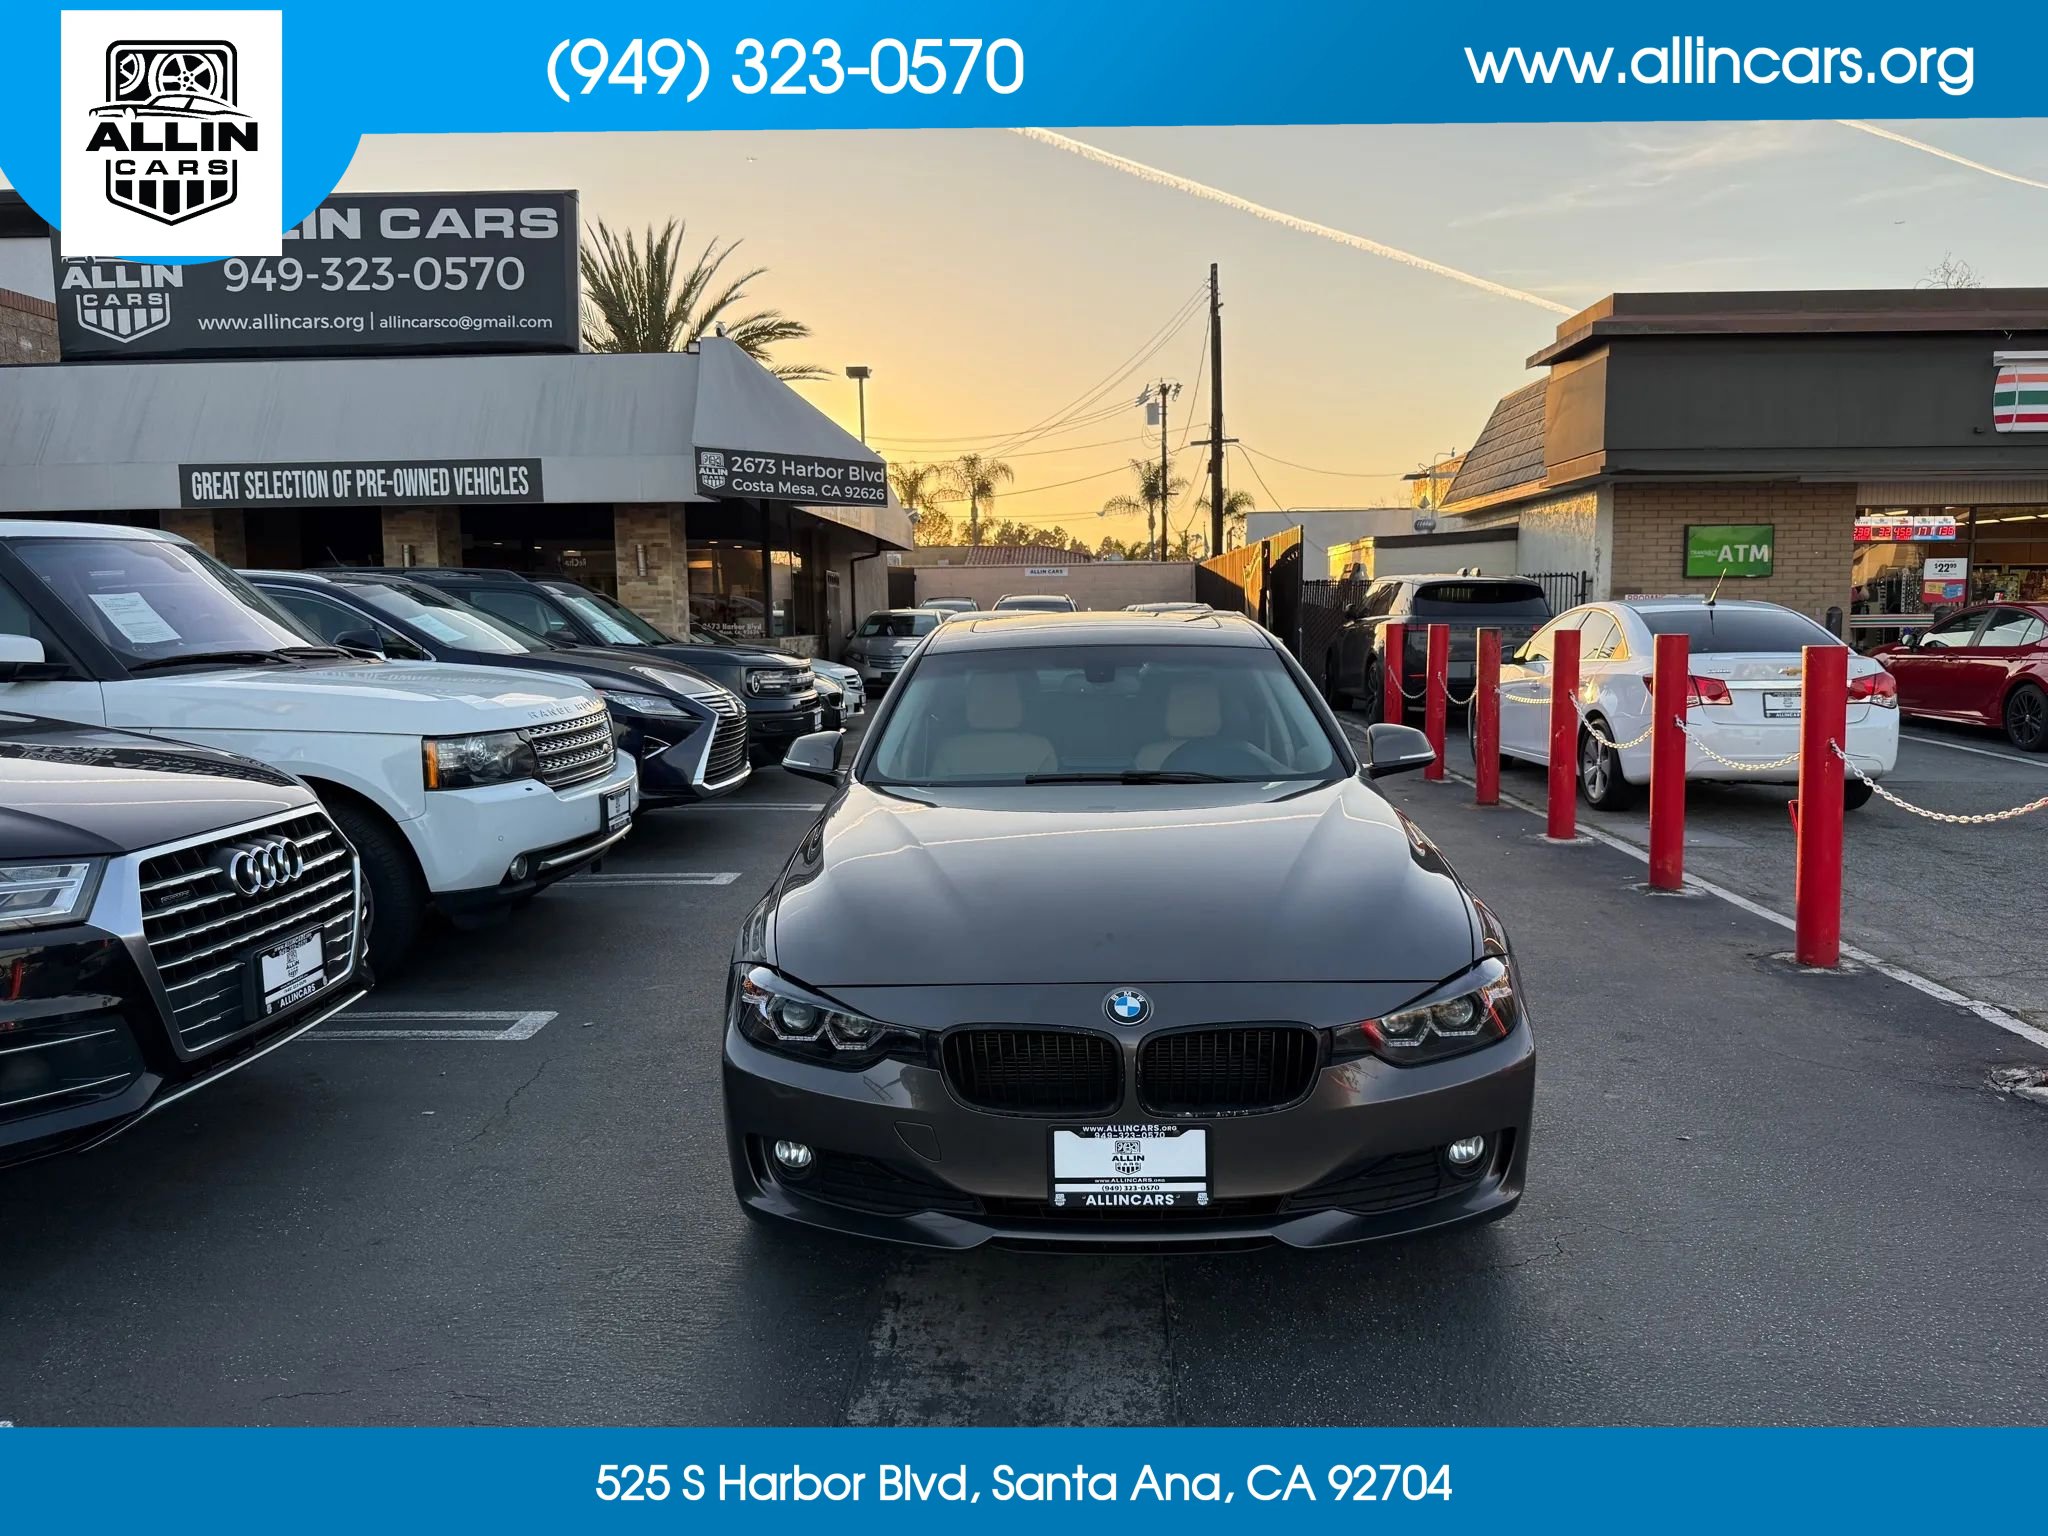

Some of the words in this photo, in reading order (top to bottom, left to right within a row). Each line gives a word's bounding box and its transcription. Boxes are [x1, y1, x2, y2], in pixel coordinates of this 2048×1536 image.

[379, 207, 559, 239] CARS
[61, 264, 184, 290] ALLIN
[223, 256, 525, 293] 949-323-0570
[83, 292, 163, 307] CARS
[198, 313, 365, 332] www.allincars.org
[379, 315, 553, 331] allincarsco@gmail.com
[699, 467, 728, 476] ALLIN
[731, 456, 777, 475] 2673
[782, 459, 844, 480] Harbor
[848, 466, 885, 484] Blvd
[191, 471, 241, 500] GREAT
[244, 469, 329, 499] SELECTION
[333, 469, 351, 498] OF
[355, 467, 450, 498] PRE-OWNED
[453, 465, 529, 496] VEHICLES
[732, 478, 774, 493] Costa
[778, 481, 818, 497] Mesa,
[821, 484, 842, 498] CA
[844, 486, 885, 501] 92626
[1717, 544, 1769, 563] ATM
[280, 983, 316, 1008] ALLINCARS
[1110, 990, 1145, 1002] BMW
[1085, 1194, 1175, 1206] ALLINCARS
